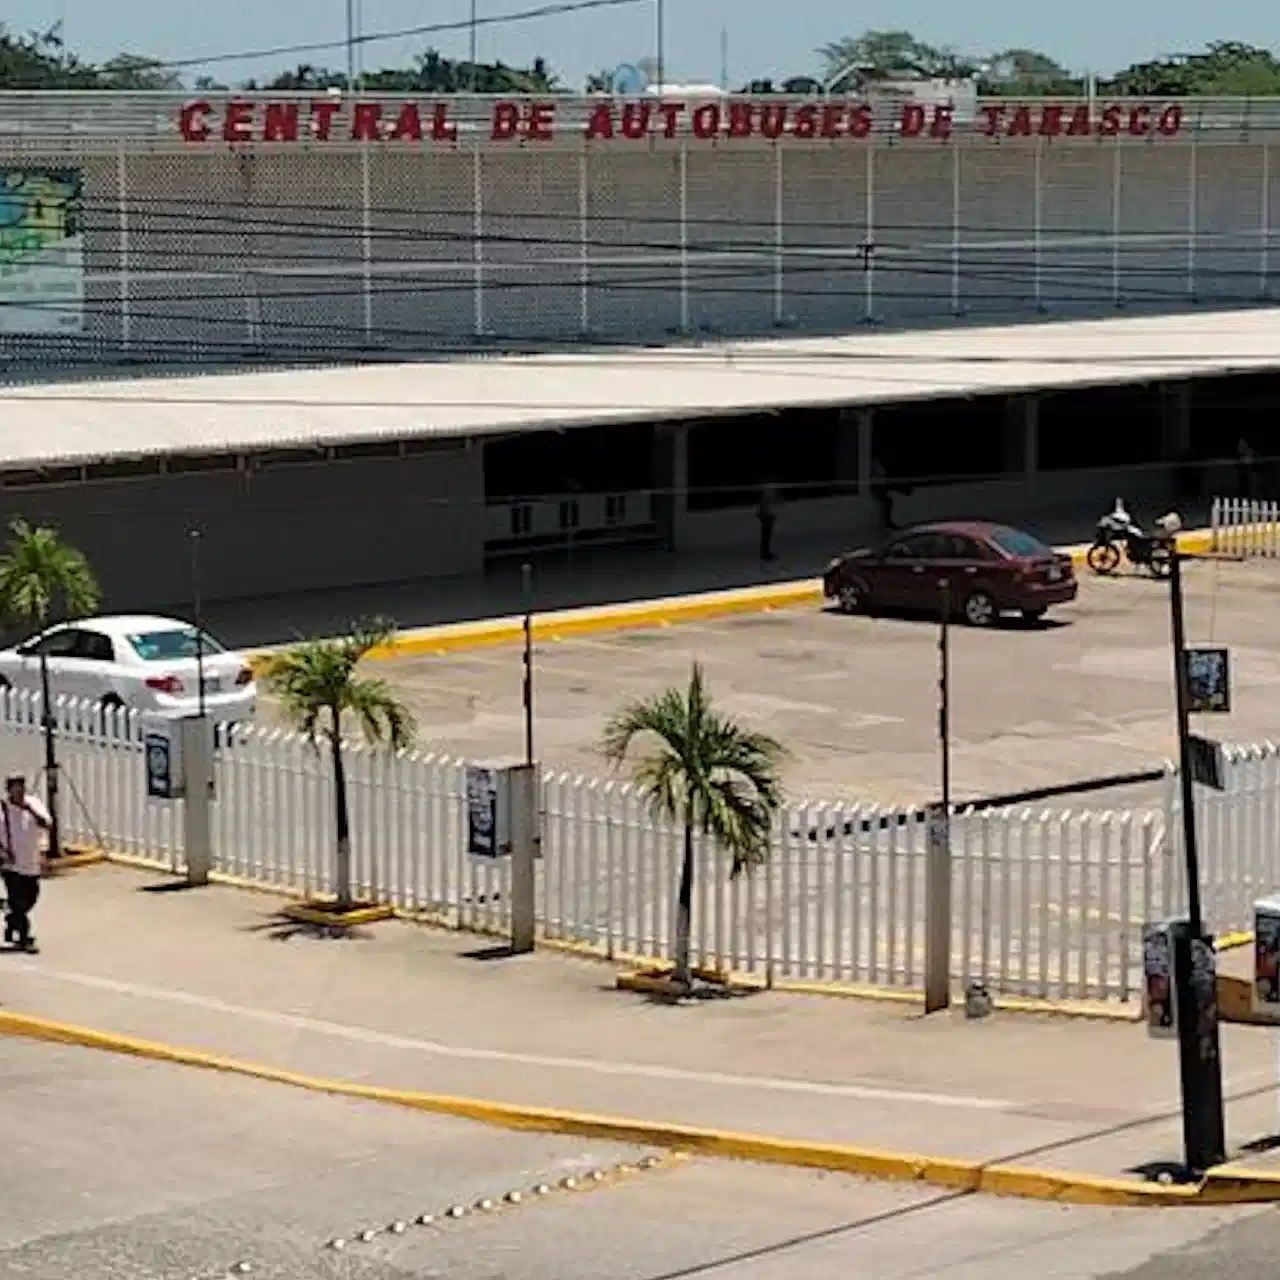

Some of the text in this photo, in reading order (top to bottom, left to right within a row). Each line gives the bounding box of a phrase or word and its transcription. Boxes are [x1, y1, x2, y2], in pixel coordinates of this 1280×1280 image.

[180, 101, 1183, 142] CENTRAL DE AUTOBUSES DE TABASCO
